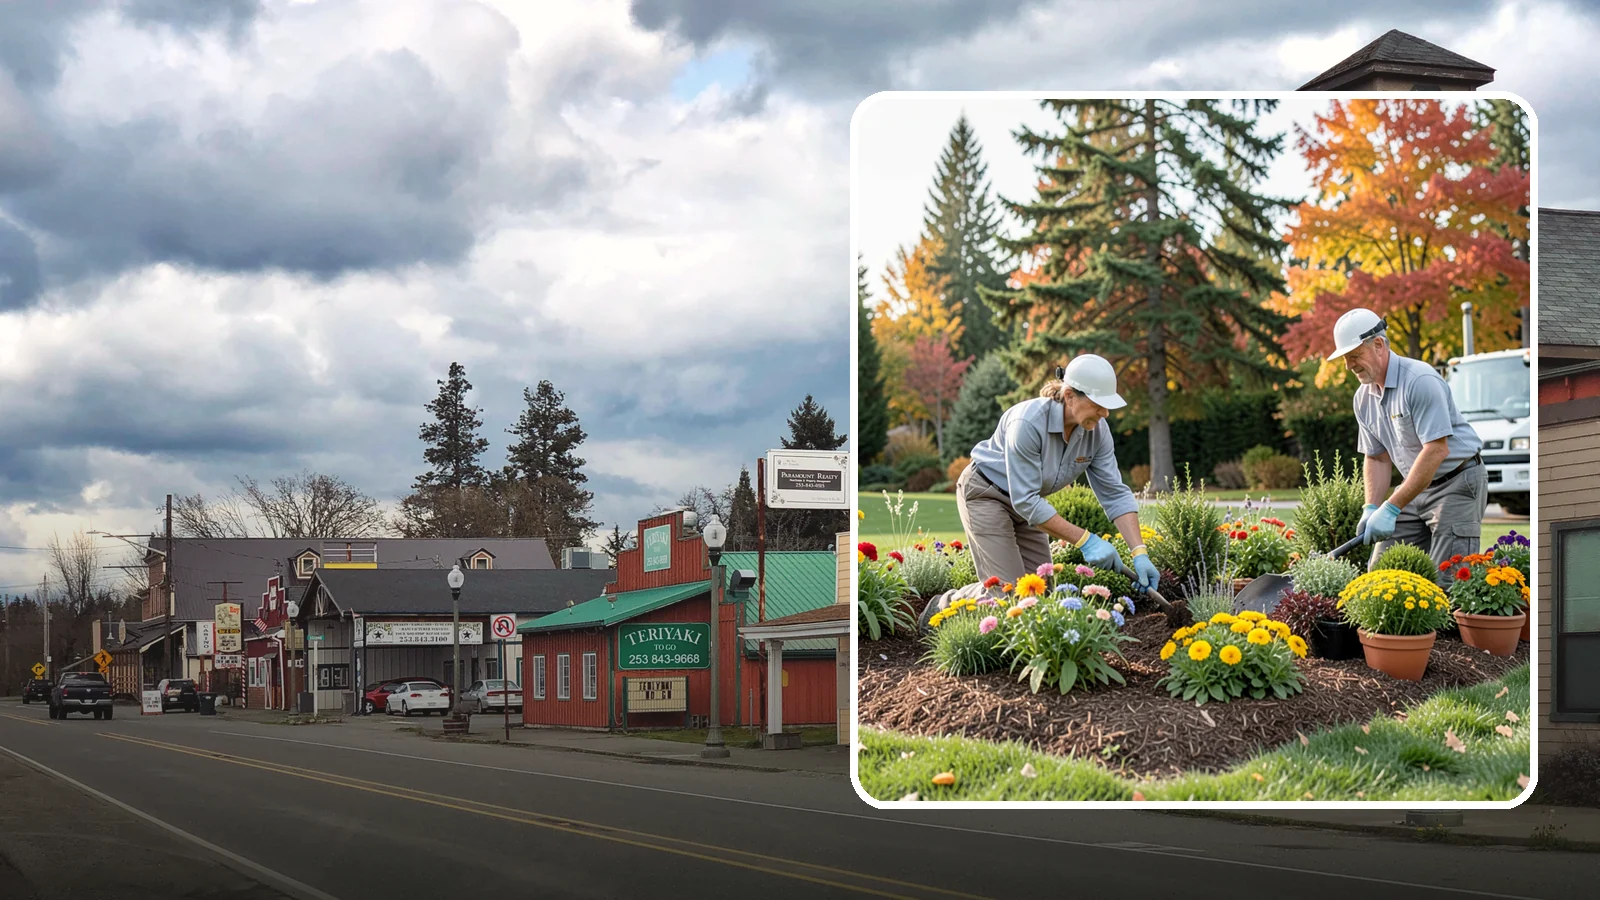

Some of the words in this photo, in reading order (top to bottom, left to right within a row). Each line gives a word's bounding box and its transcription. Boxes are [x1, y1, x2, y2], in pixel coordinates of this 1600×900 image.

[781, 471, 814, 479] PARAMOUNT
[817, 472, 839, 480] REALTY
[624, 627, 702, 646] TERIYAKI
[628, 654, 649, 665] 253
[651, 653, 700, 664] 843-9668
